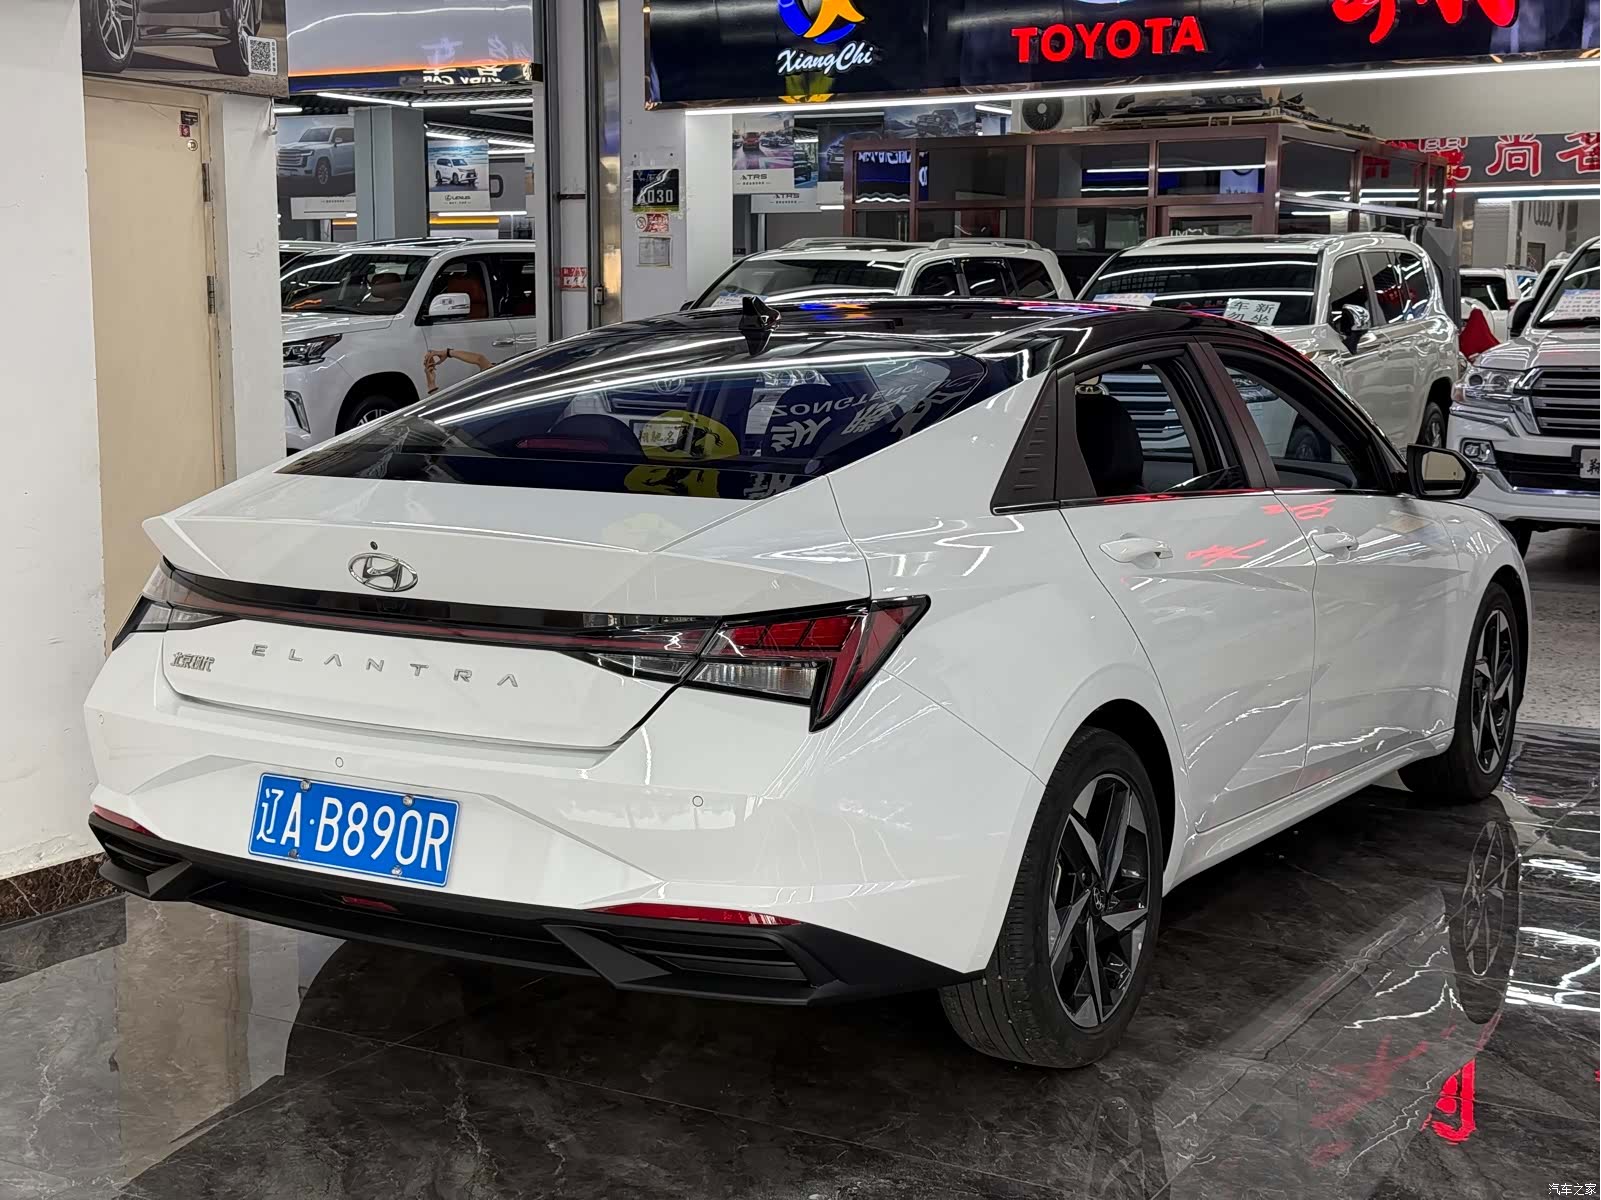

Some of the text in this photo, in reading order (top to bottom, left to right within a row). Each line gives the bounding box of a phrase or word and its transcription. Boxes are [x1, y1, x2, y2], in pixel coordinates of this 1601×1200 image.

[777, 42, 873, 75] XiangChi
[1011, 16, 1205, 63] TOYOTA
[251, 643, 519, 688] ELANTRA
